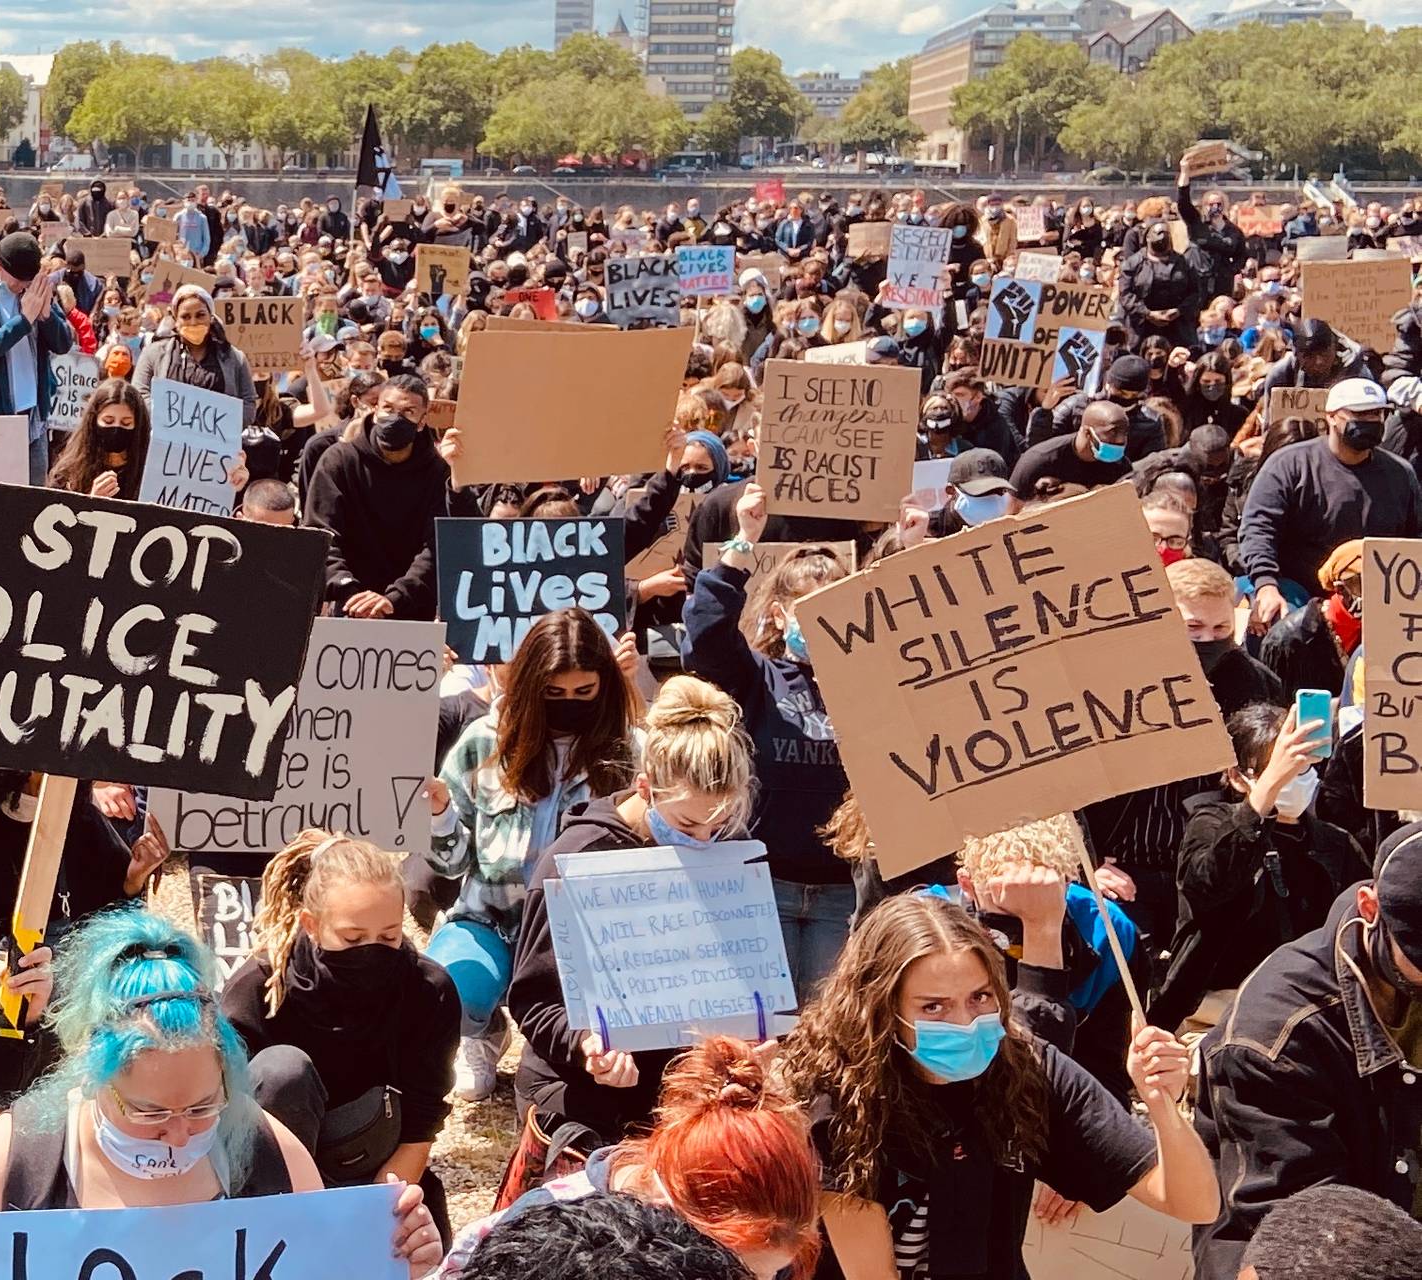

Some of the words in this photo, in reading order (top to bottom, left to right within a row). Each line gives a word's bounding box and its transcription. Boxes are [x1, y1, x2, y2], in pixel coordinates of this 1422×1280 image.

[607, 258, 679, 284] BLACK
[679, 260, 727, 274] LIVES
[680, 250, 727, 262] BLACK
[610, 286, 680, 310] LIVES
[679, 275, 729, 289] MATTER
[224, 302, 295, 326] BLACK
[1037, 284, 1108, 320] POWER
[1033, 328, 1059, 346] OF
[55, 364, 98, 389] Silence
[981, 343, 1055, 385] UNITY
[778, 374, 796, 401] I
[804, 377, 846, 406] SEE
[849, 378, 883, 408] NO
[1281, 389, 1310, 410] NO
[163, 390, 228, 443] BLACK
[879, 409, 909, 425] ALL
[762, 423, 778, 444] I
[781, 425, 828, 446] CAN
[835, 428, 885, 450] SEE
[162, 441, 232, 484] LIVES
[768, 446, 797, 471] IS
[802, 449, 882, 480] RACIST
[774, 472, 861, 504] FACES
[20, 502, 242, 593] STOP
[481, 520, 609, 567] BLACK
[816, 523, 1065, 655] WHITE
[1372, 549, 1422, 605] YO
[897, 564, 1174, 688] SILENCE
[316, 643, 438, 692] comes
[969, 665, 1029, 721] IS
[772, 737, 838, 766] YANK
[888, 674, 1214, 796] VIOLENCE
[322, 746, 352, 790] is
[174, 788, 371, 850] betrayal
[578, 887, 605, 911] WE
[610, 881, 657, 904] WERE
[695, 876, 745, 900] HUMAN
[556, 919, 571, 944] ALL
[589, 920, 645, 948] UNTIL
[648, 913, 690, 936] RACE
[624, 947, 691, 971] RELIGION
[697, 936, 769, 960] SEPARATED
[628, 972, 689, 997] POLITICS
[691, 965, 756, 987] DIVIDED
[607, 1005, 634, 1027] AND
[637, 1002, 684, 1025] WEALTH
